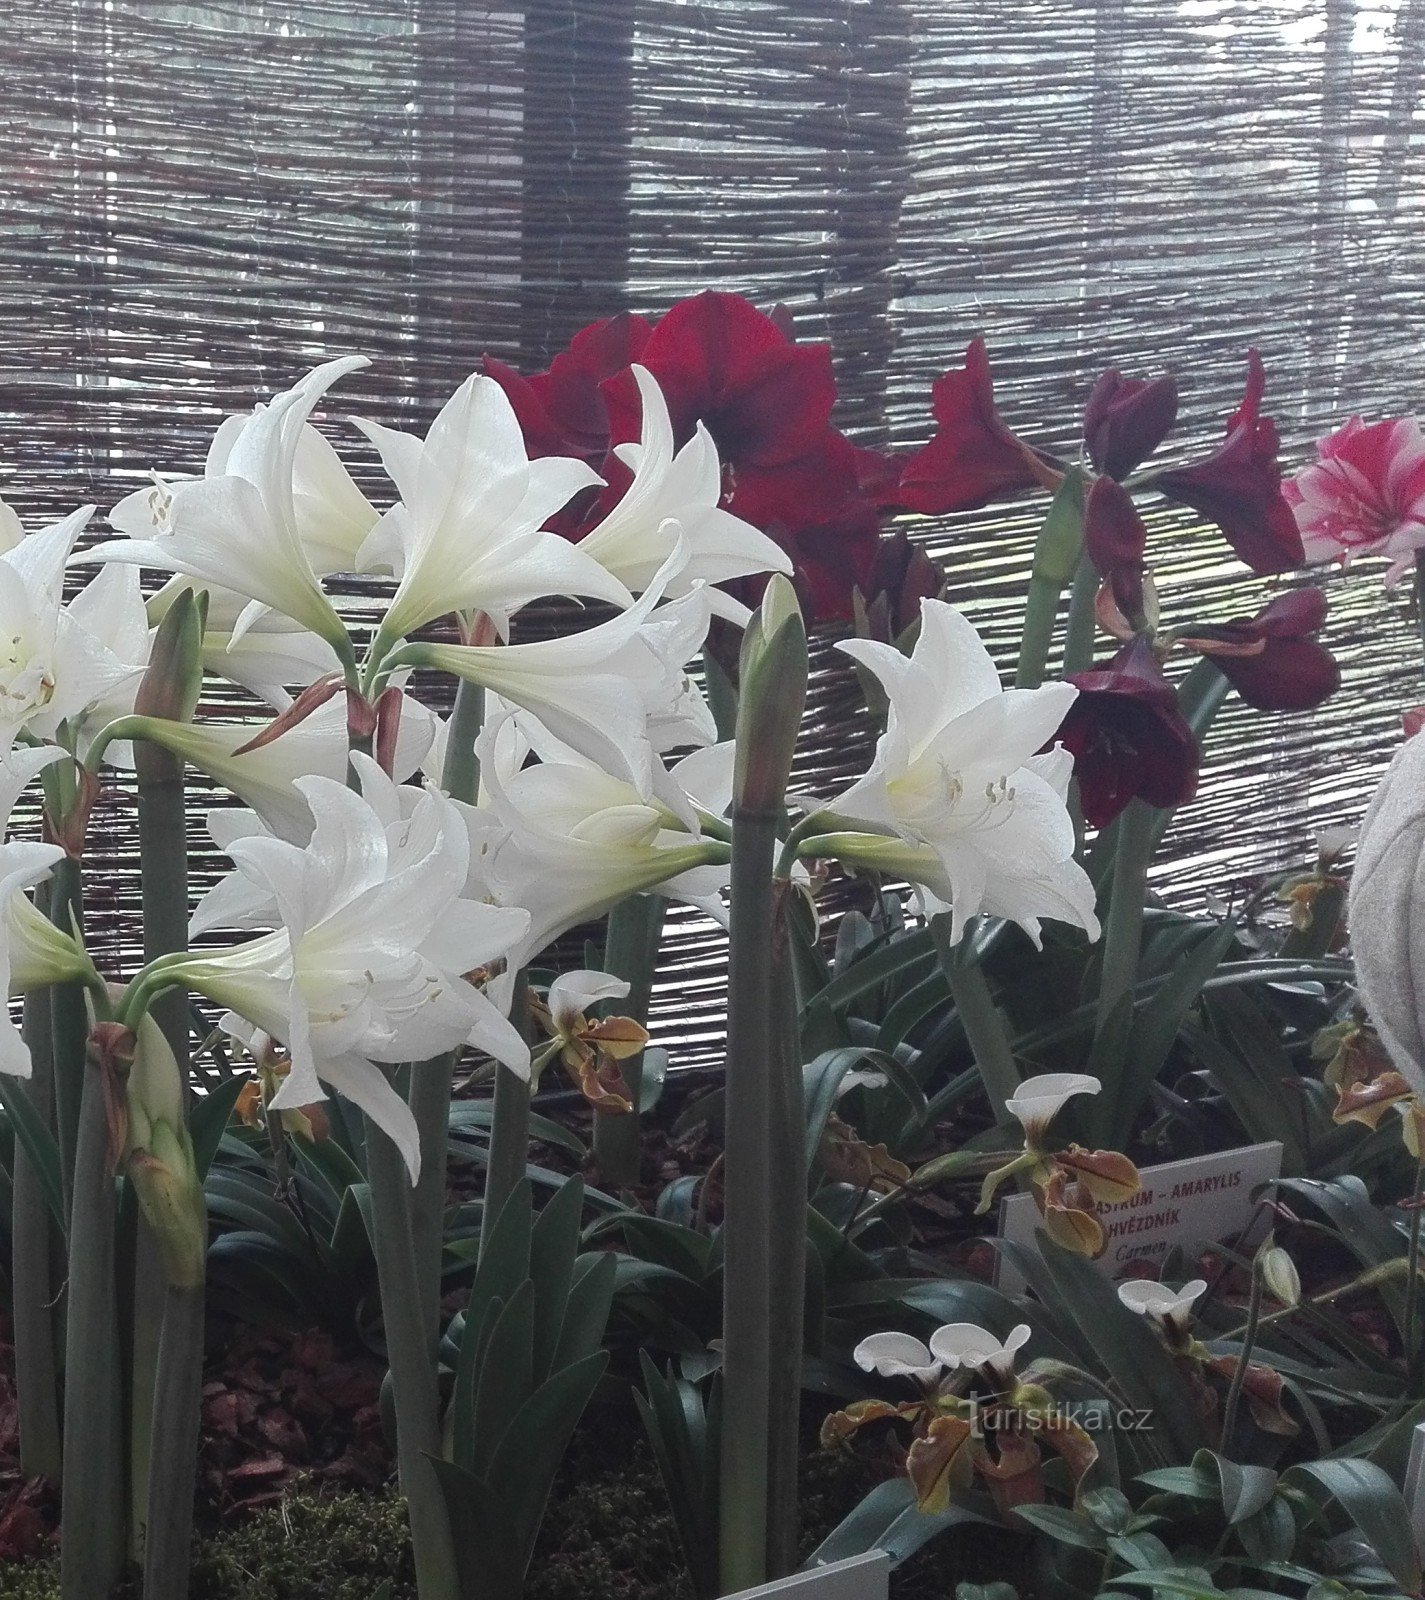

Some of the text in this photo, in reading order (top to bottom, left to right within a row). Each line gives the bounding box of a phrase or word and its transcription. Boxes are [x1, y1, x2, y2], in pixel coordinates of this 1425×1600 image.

[1170, 1171, 1242, 1199] AMARYLIS
[1108, 1208, 1182, 1238] HVĚZDNÍK
[1116, 1241, 1167, 1262] Carmen
